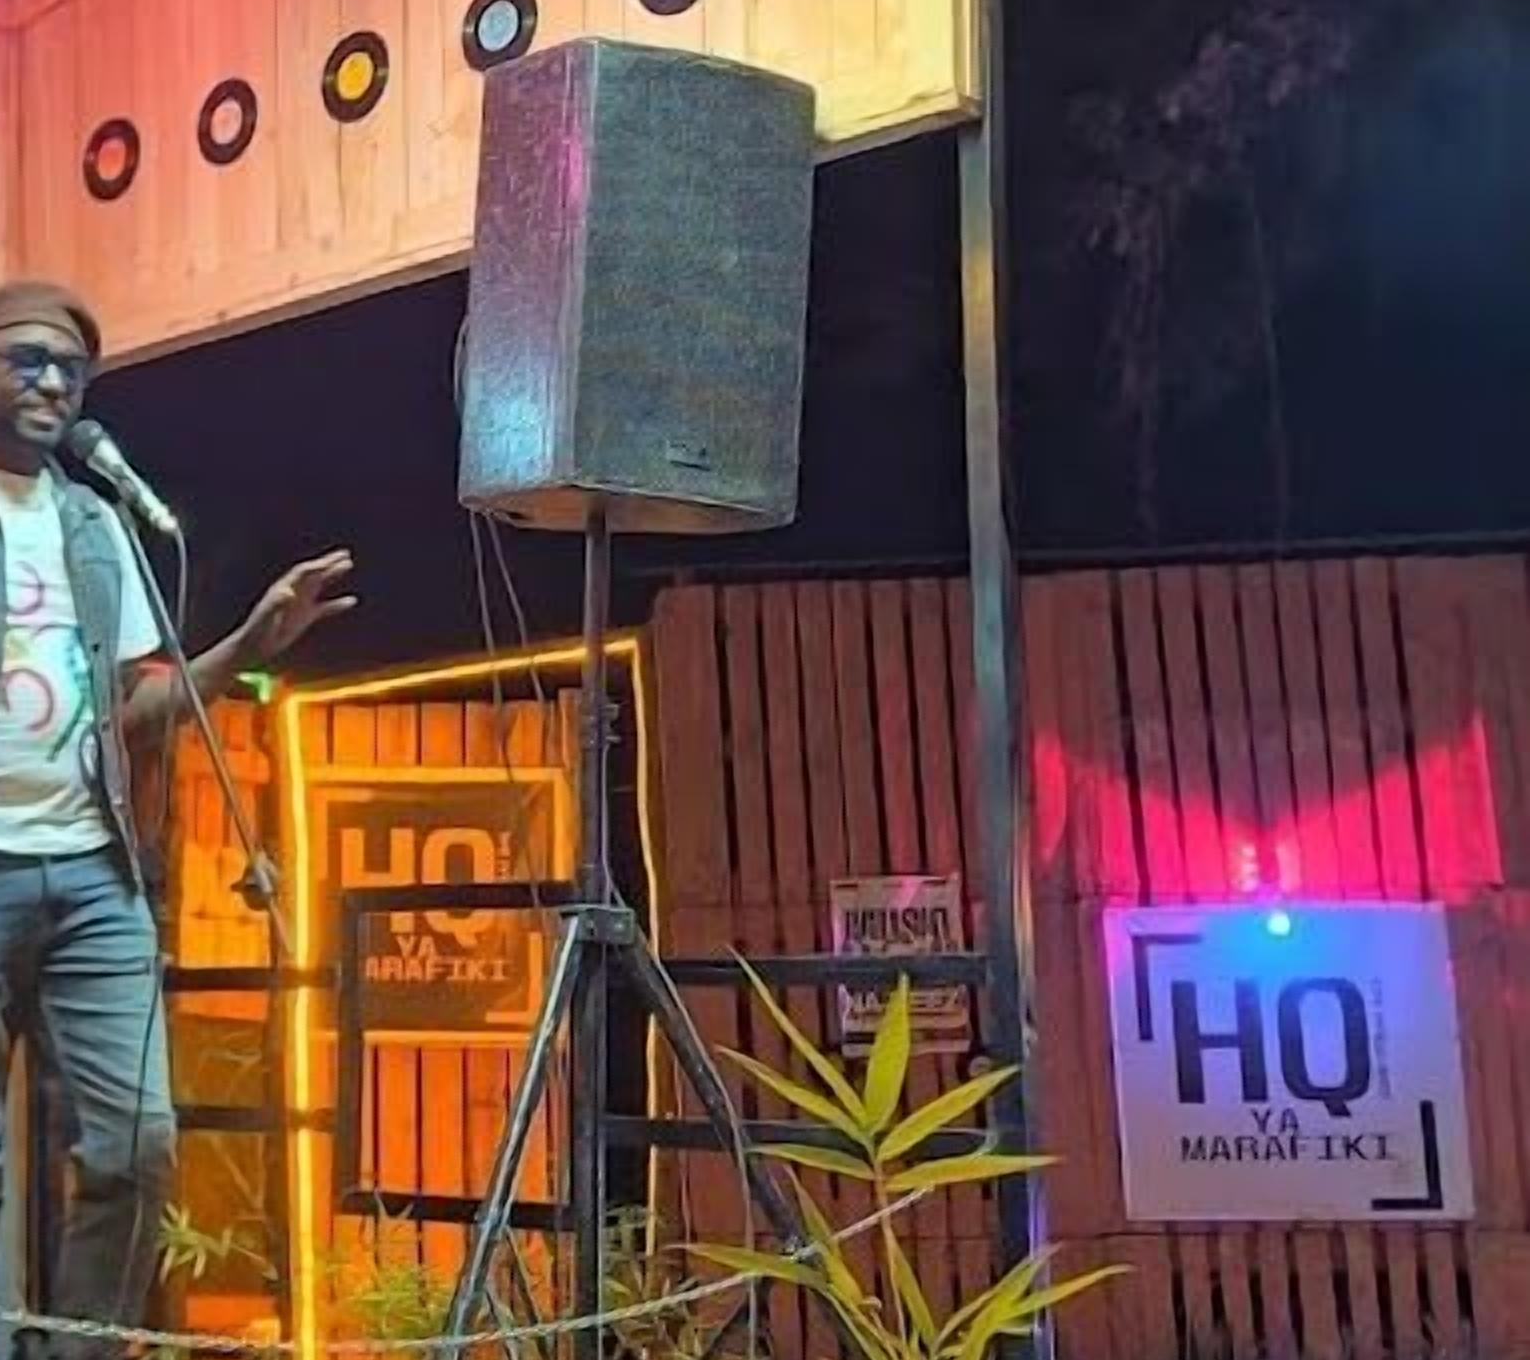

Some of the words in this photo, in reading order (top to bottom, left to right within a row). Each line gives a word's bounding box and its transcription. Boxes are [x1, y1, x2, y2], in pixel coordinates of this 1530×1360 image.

[340, 827, 495, 948] HQ
[365, 955, 512, 981] ARAFIKI
[1171, 977, 1371, 1117] HQ
[1251, 1108, 1300, 1133] YA
[1180, 1134, 1395, 1161] MARAFIKI
